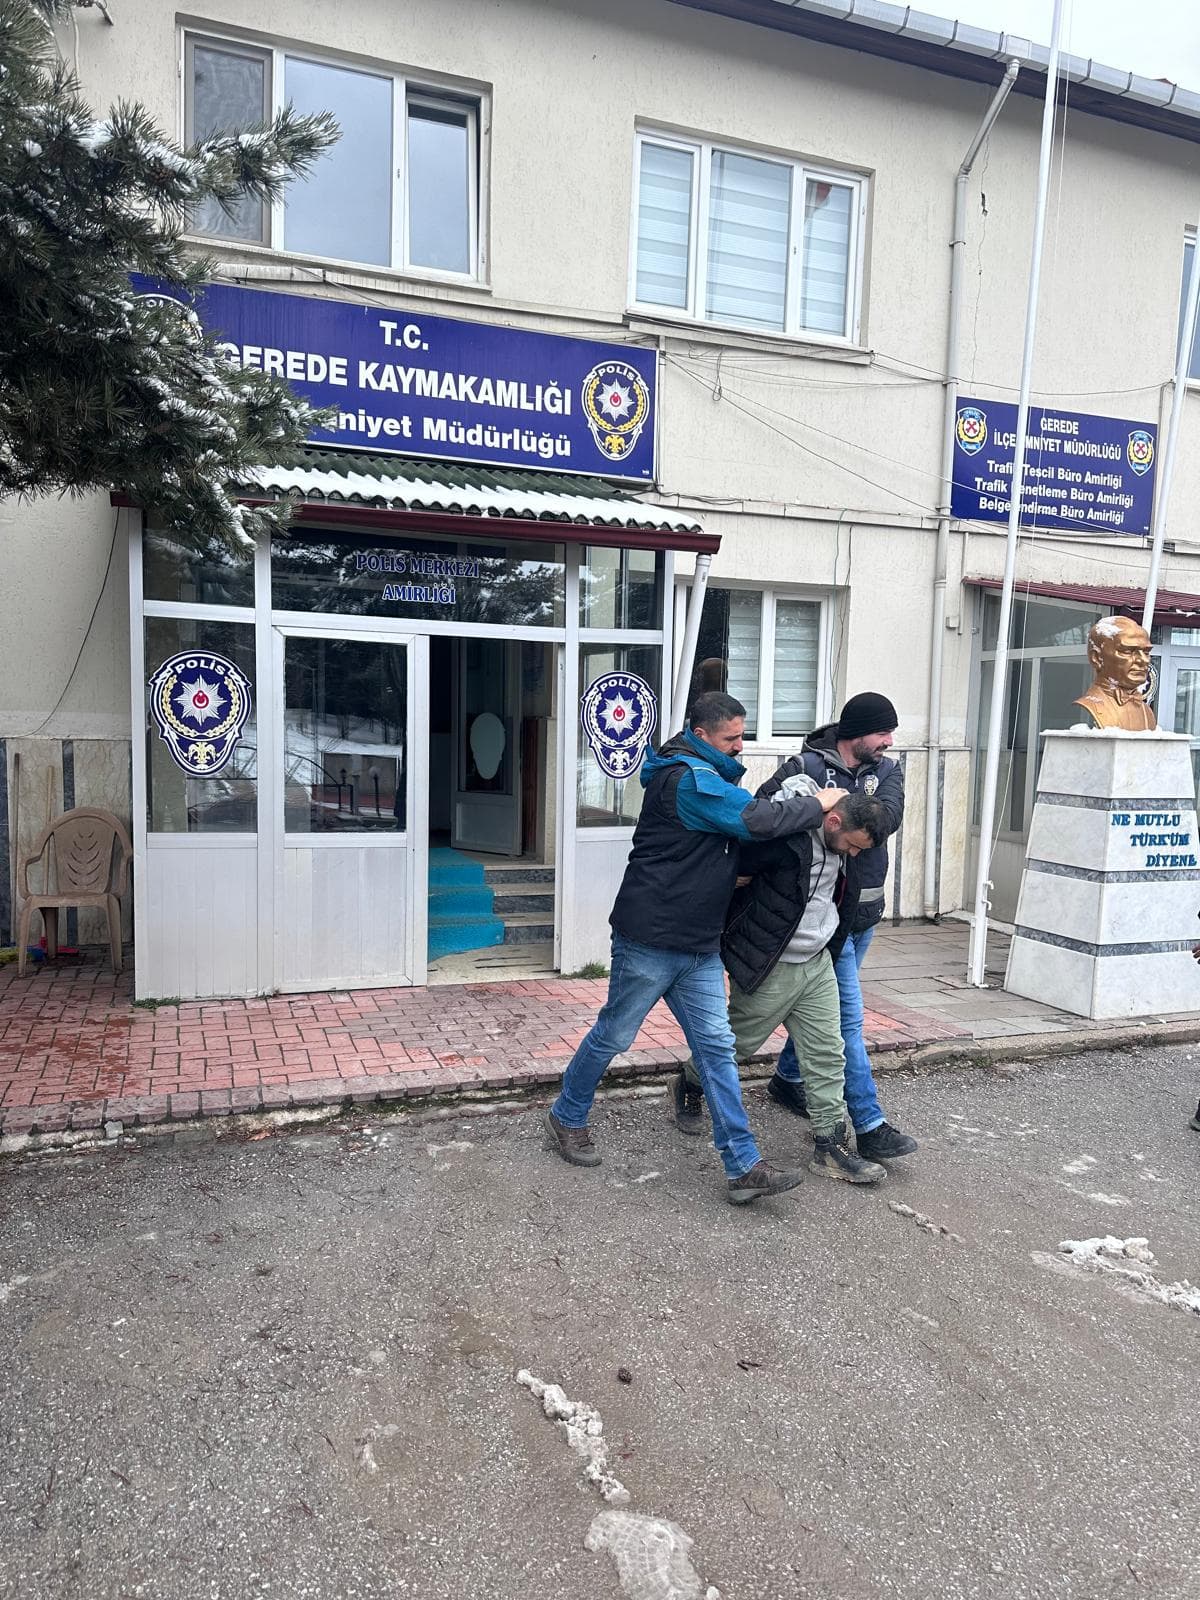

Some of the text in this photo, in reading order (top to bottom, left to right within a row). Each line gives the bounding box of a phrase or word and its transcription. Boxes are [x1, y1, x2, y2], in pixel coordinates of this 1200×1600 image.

[379, 320, 429, 350] T.C.
[598, 365, 635, 381] POLİS
[358, 360, 572, 415] KAYMAKAMLIĞI
[338, 409, 571, 459] niyet Müdürlüğü
[1040, 417, 1079, 435] GEREDE
[993, 428, 1017, 450] İLÇE
[1025, 435, 1061, 453] MNİYET
[1063, 439, 1121, 460] MÜDÜRLÜĞÜ
[987, 460, 1014, 474] Trafi
[1057, 467, 1082, 482] Büro
[1084, 471, 1123, 489] Amirliği
[974, 477, 1134, 508] Trafik enetleme Büro Amirliği
[1060, 504, 1084, 518] Büro
[1086, 507, 1124, 525] Amirliği
[382, 581, 456, 604] AMİRLİĞİ
[175, 659, 226, 675] POLİS
[600, 678, 639, 692] POLİS
[1111, 814, 1181, 827] NE MUTLU
